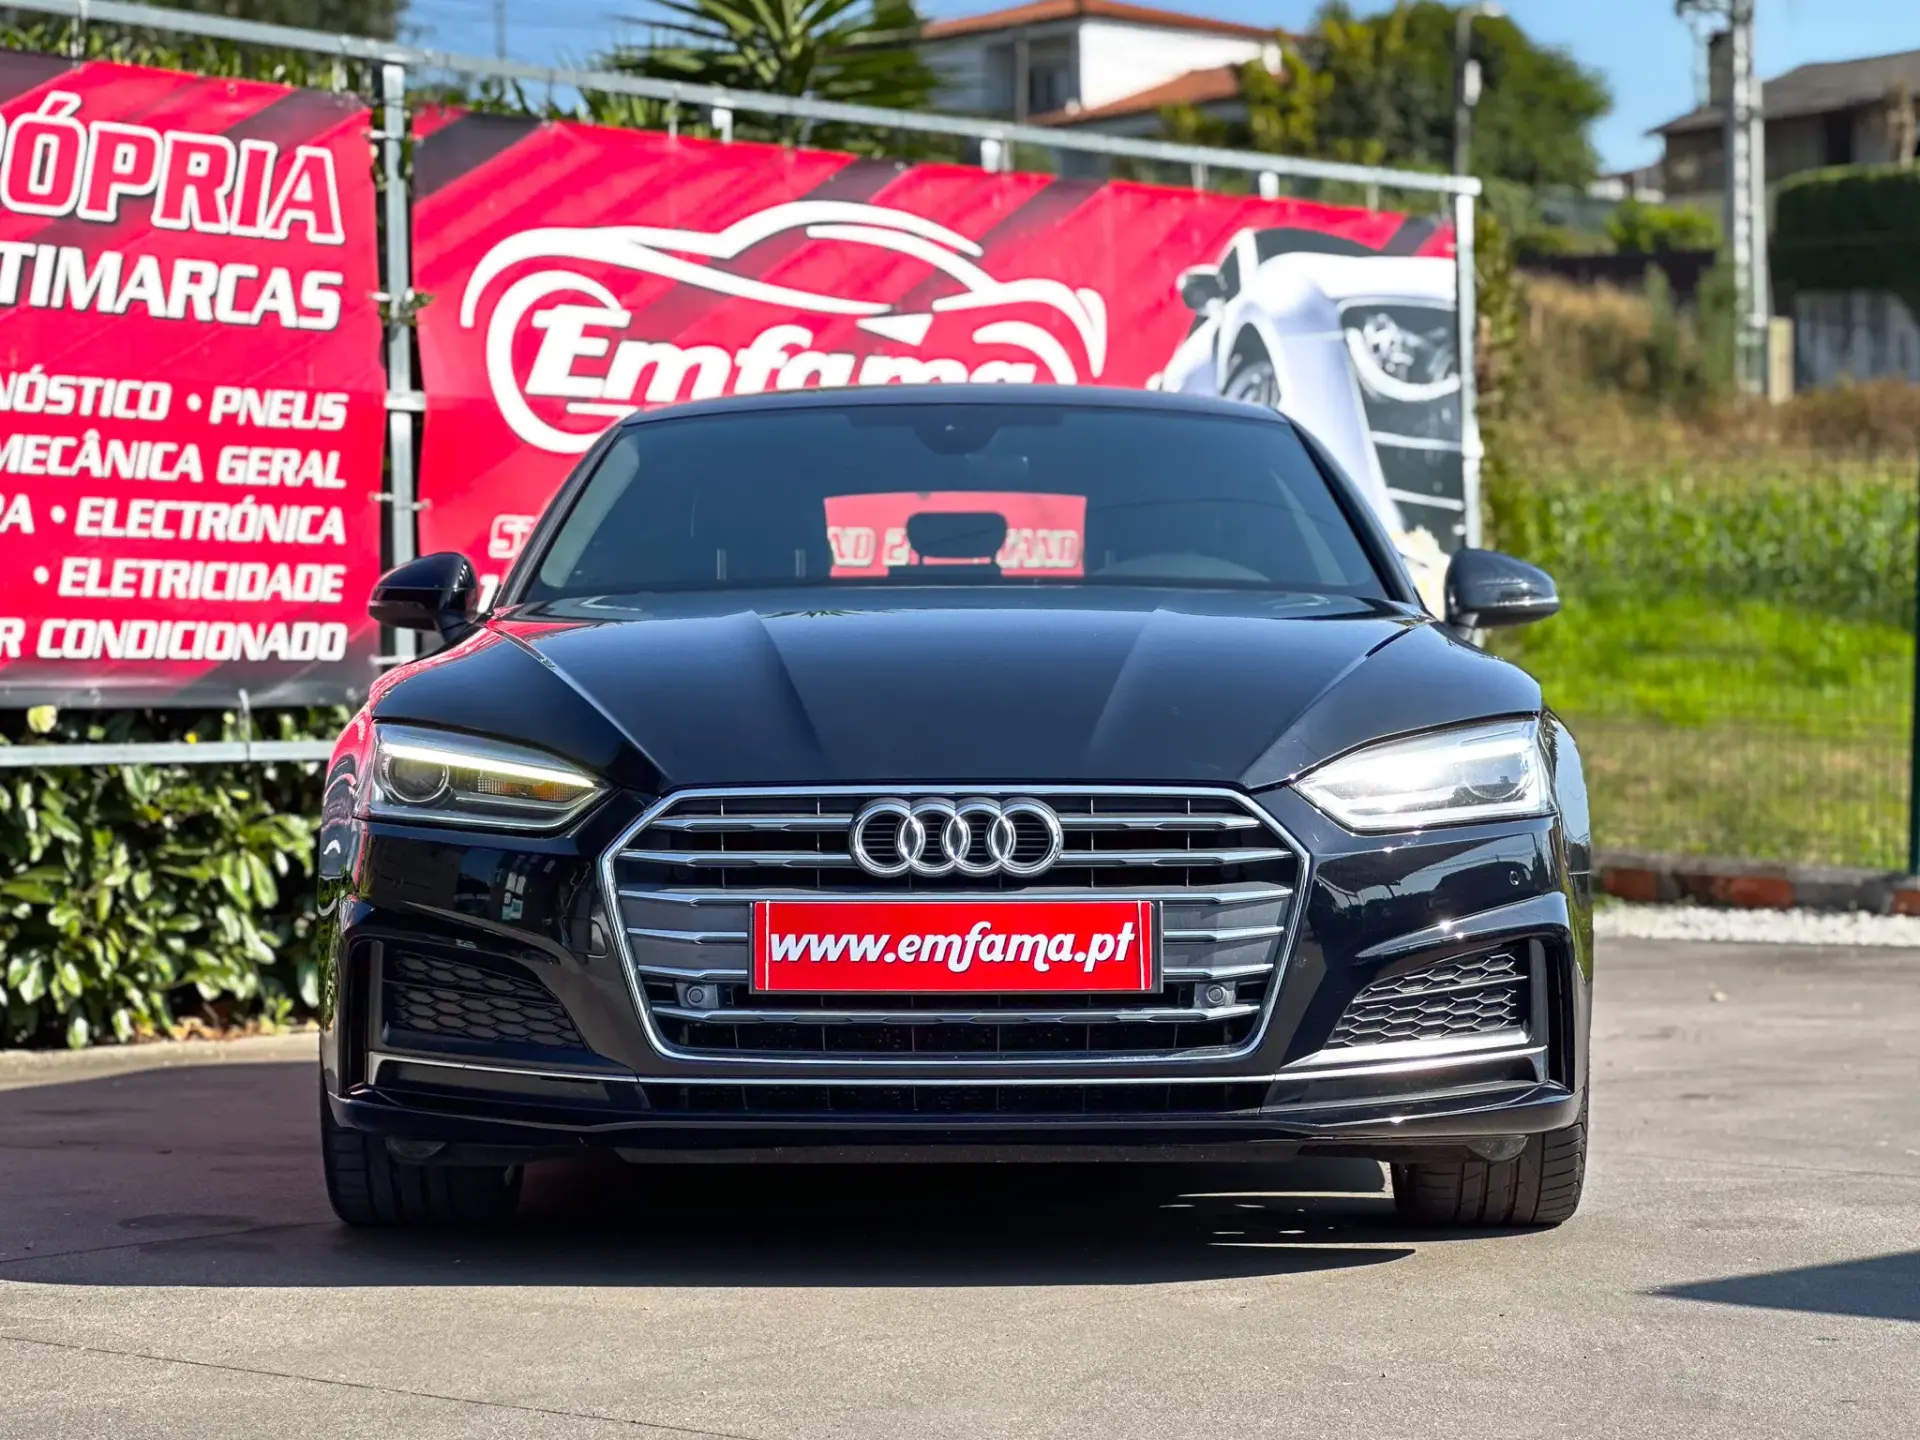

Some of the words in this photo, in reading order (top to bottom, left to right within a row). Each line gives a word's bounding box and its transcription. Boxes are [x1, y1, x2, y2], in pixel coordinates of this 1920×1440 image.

[0, 91, 346, 246] ÓPRIA
[0, 242, 344, 331] TIMARCAS
[209, 386, 348, 431] PNEUS
[216, 446, 347, 489] GERAL
[0, 493, 35, 534] A
[74, 494, 346, 545] ELECTRÓNICA
[58, 556, 347, 603] ELETRICIDADE
[37, 618, 348, 662] CONDICIONADO
[771, 921, 1135, 973] www.emfama.pt
